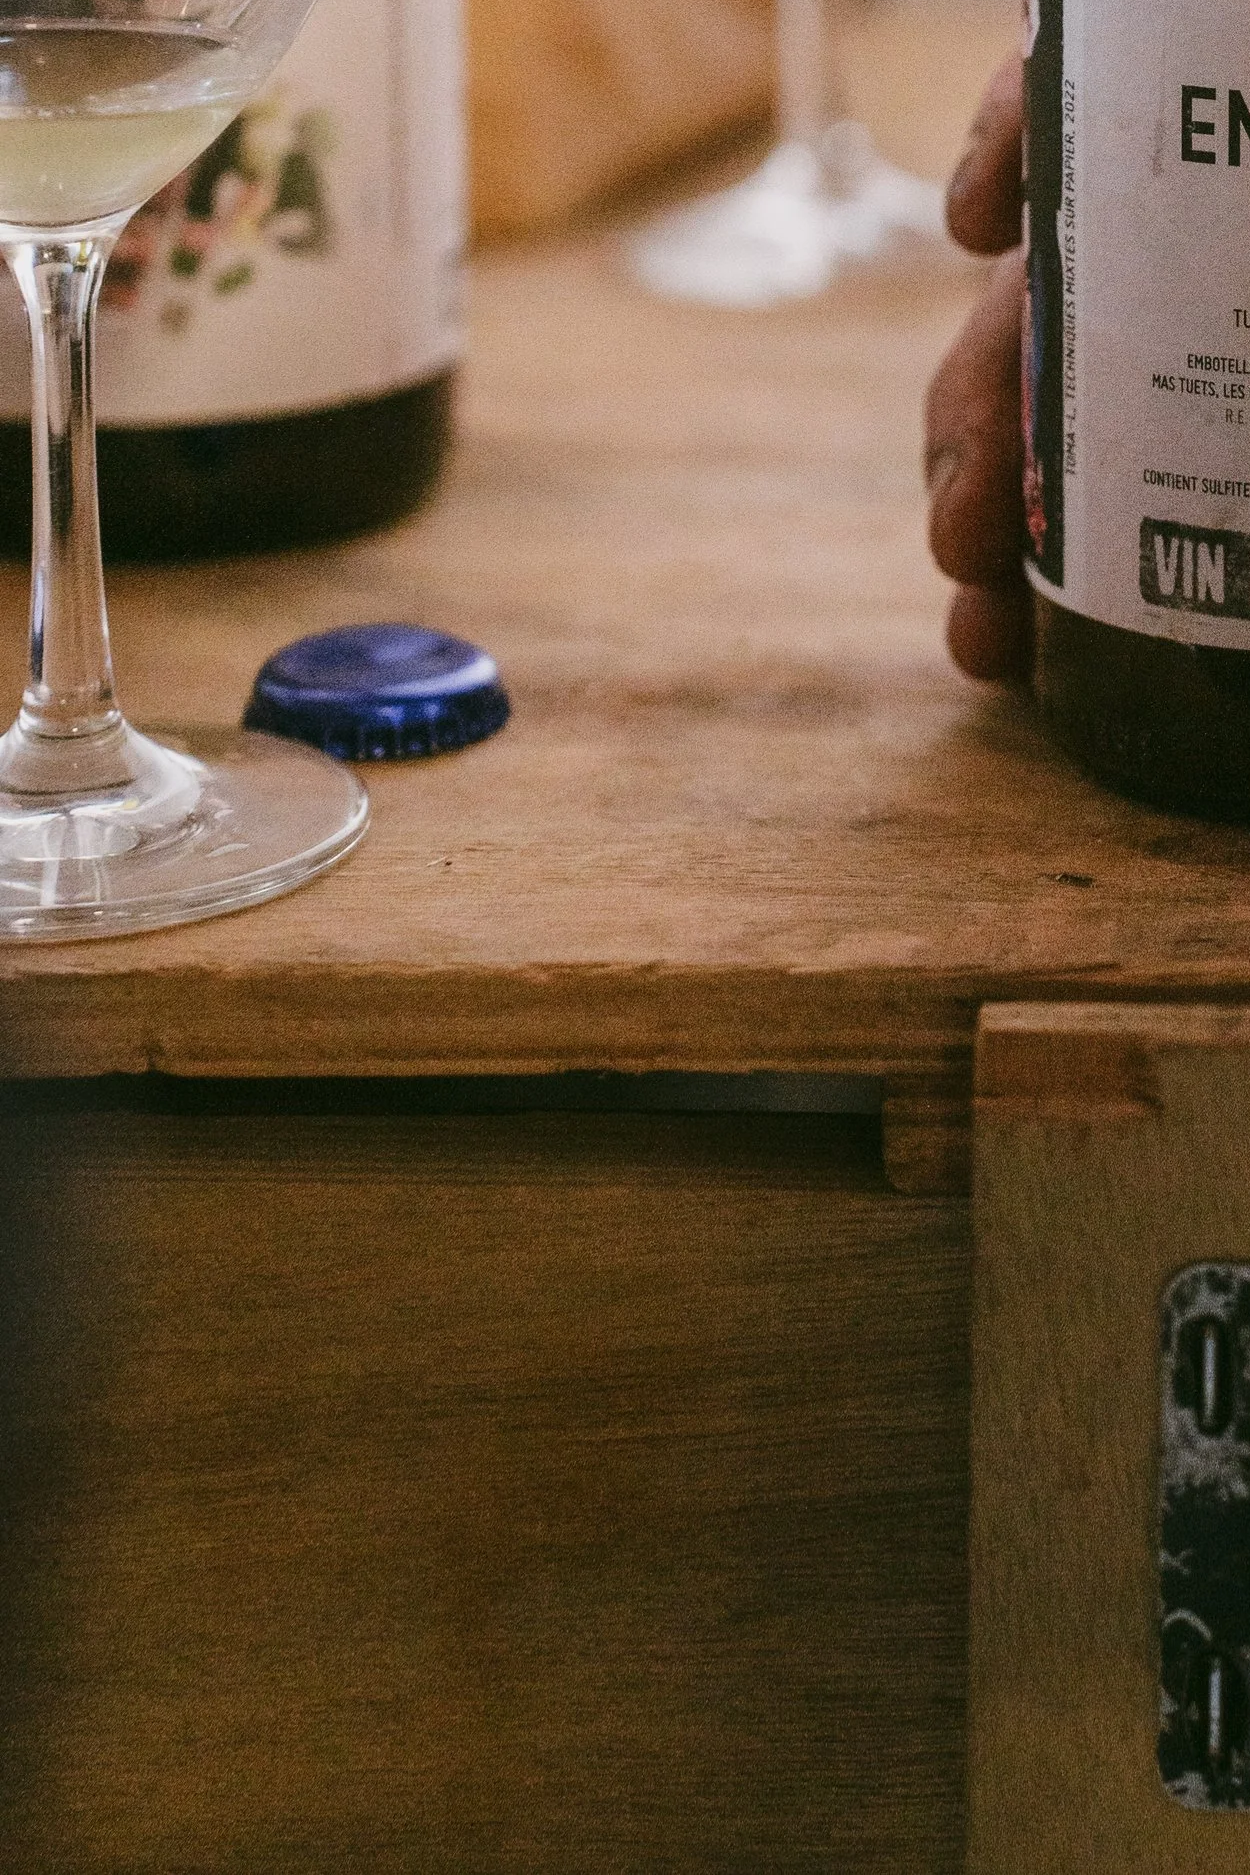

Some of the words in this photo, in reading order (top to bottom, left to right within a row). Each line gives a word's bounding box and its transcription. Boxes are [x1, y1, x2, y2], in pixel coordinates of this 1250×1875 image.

[1064, 79, 1076, 124] 2022
[1064, 196, 1076, 231] SUR
[1064, 234, 1077, 295] MIXTES
[1065, 299, 1077, 400] TECHNIQUES
[1151, 373, 1176, 392] MAS
[1223, 383, 1246, 400] LES
[1143, 468, 1199, 491] CONTIENT
[1153, 534, 1226, 605] VIN
